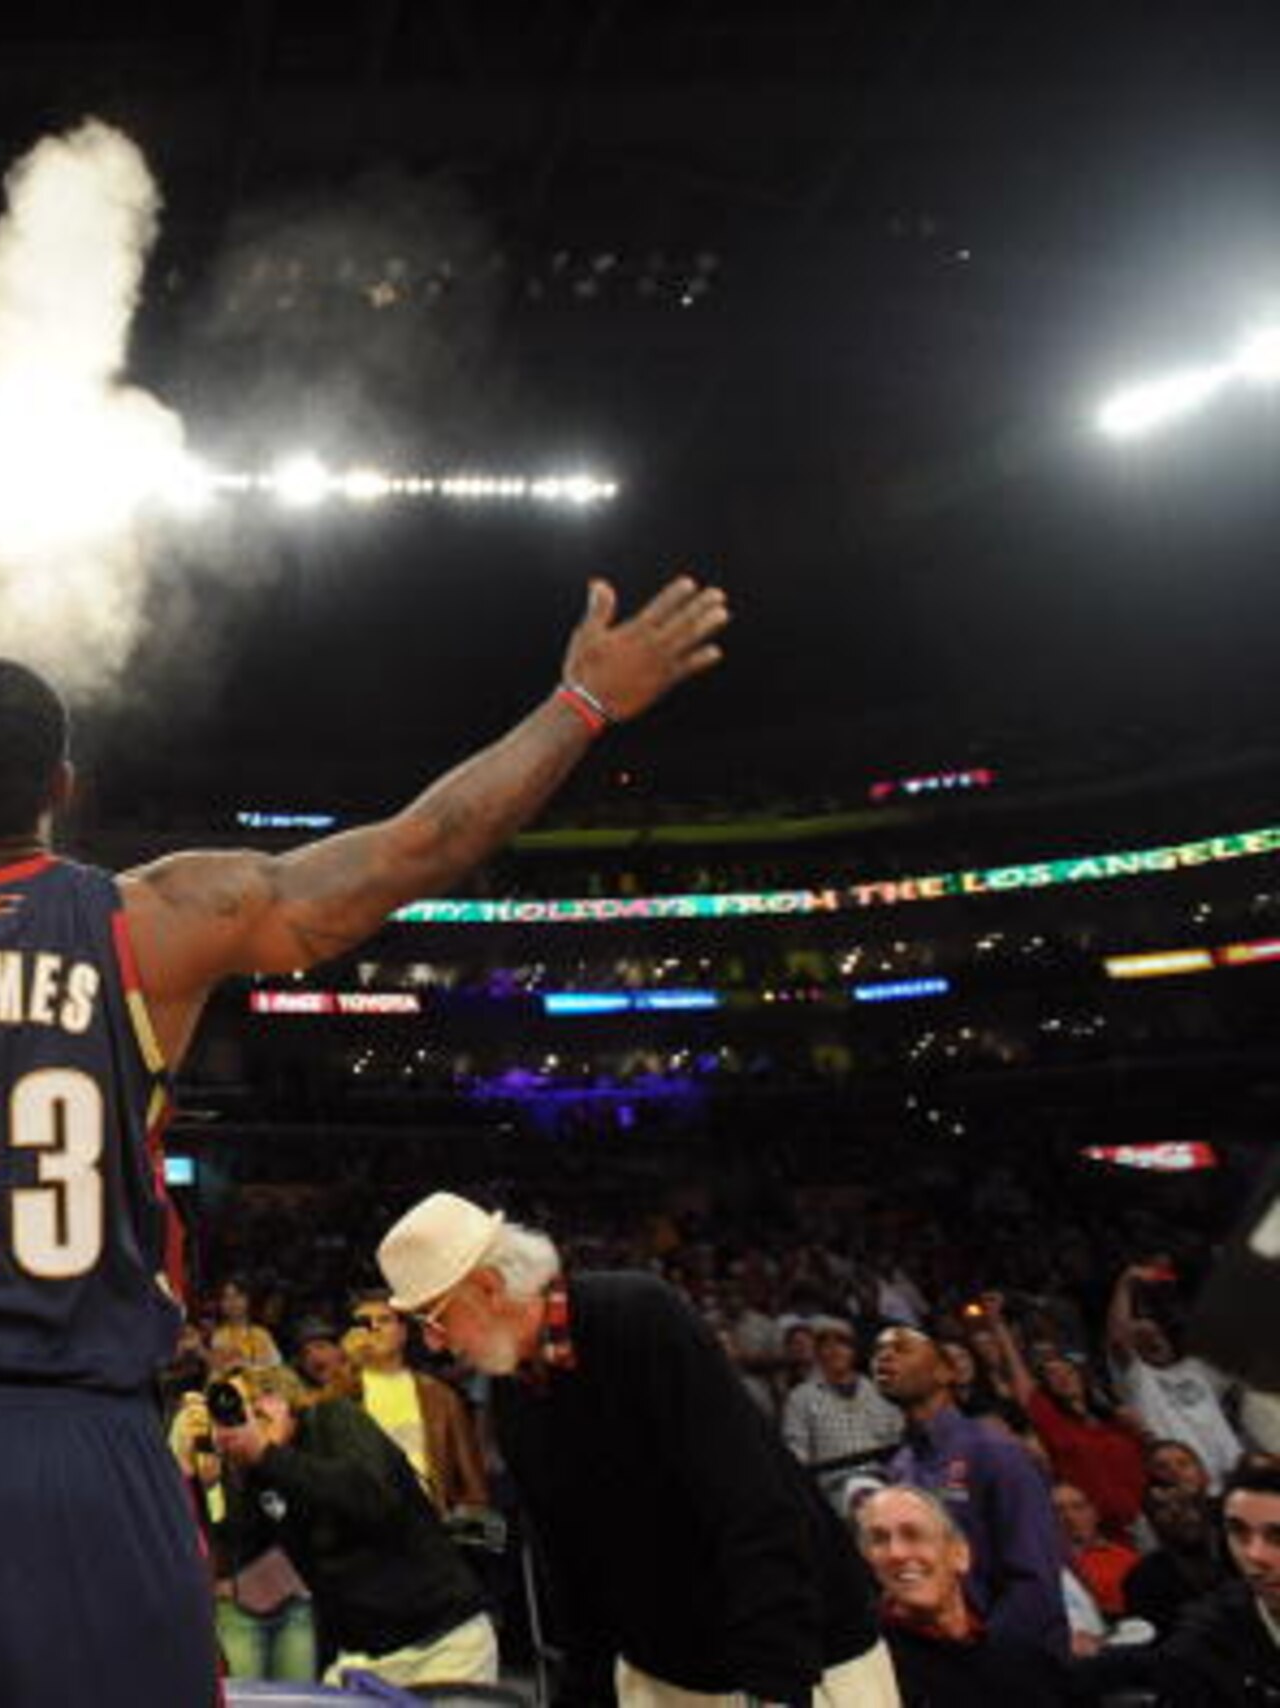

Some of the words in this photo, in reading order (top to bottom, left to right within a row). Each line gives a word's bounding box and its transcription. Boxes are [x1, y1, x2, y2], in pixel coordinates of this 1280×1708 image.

[713, 889, 839, 915] FROM
[851, 877, 949, 905] THE
[963, 865, 1052, 892] LOS
